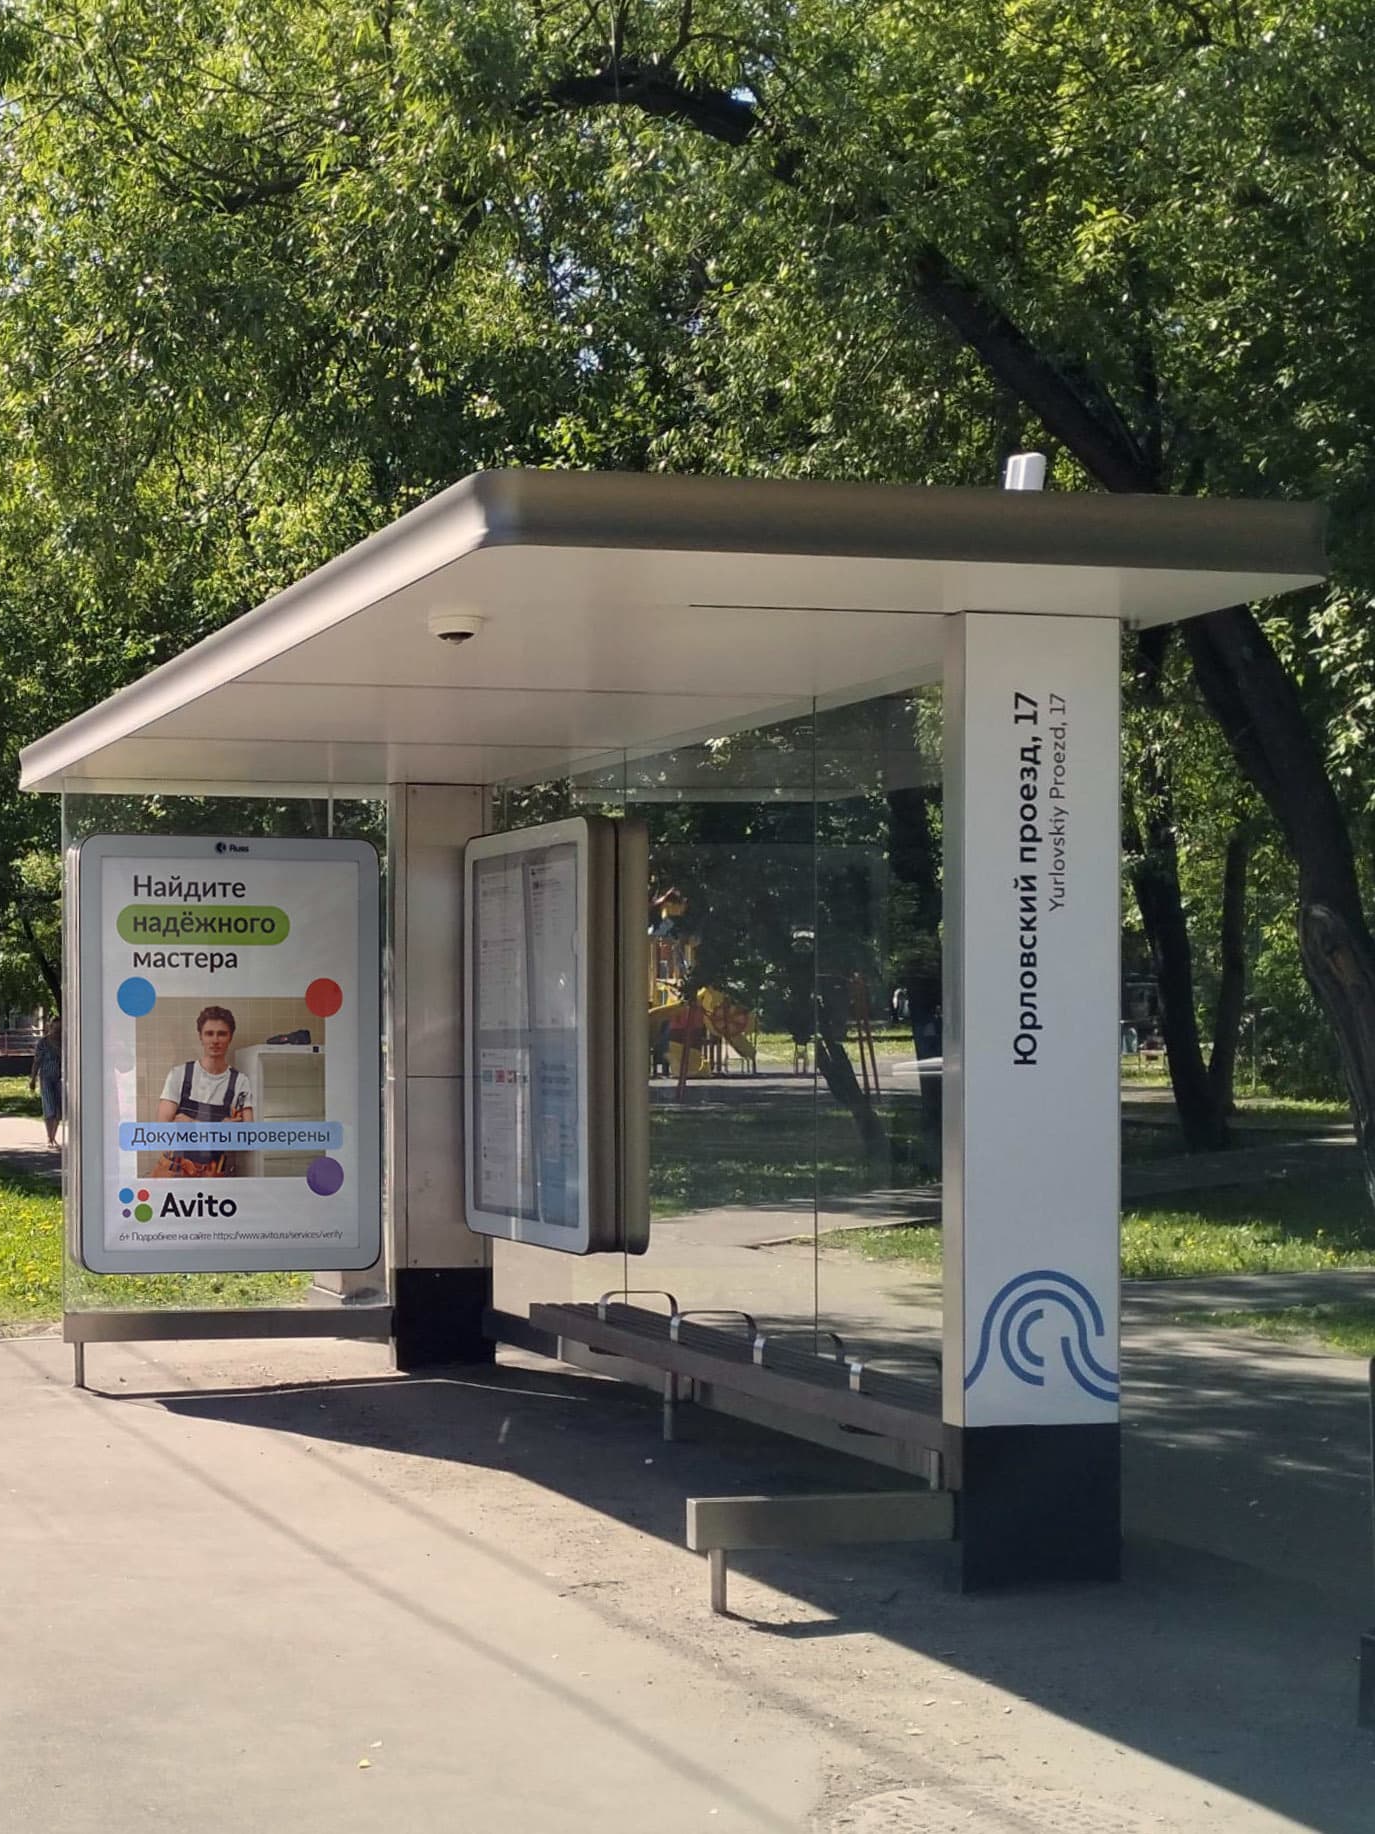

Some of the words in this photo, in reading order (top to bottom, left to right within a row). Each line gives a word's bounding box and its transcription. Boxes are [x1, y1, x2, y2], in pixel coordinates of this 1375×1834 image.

[1014, 691, 1038, 725] 17
[1049, 692, 1067, 715] 17
[1048, 719, 1070, 801] Proezd,
[1017, 735, 1043, 863] проезд,
[1048, 806, 1070, 912] Yurlovskiy
[133, 875, 246, 902] Найдите
[133, 911, 276, 938] надёжного
[133, 951, 238, 973] мастера
[1014, 876, 1043, 1066] Юрловский
[131, 1127, 232, 1146] Документы
[237, 1129, 331, 1146] проверены
[159, 1191, 238, 1218] Avito
[131, 1231, 178, 1242] Подробнее
